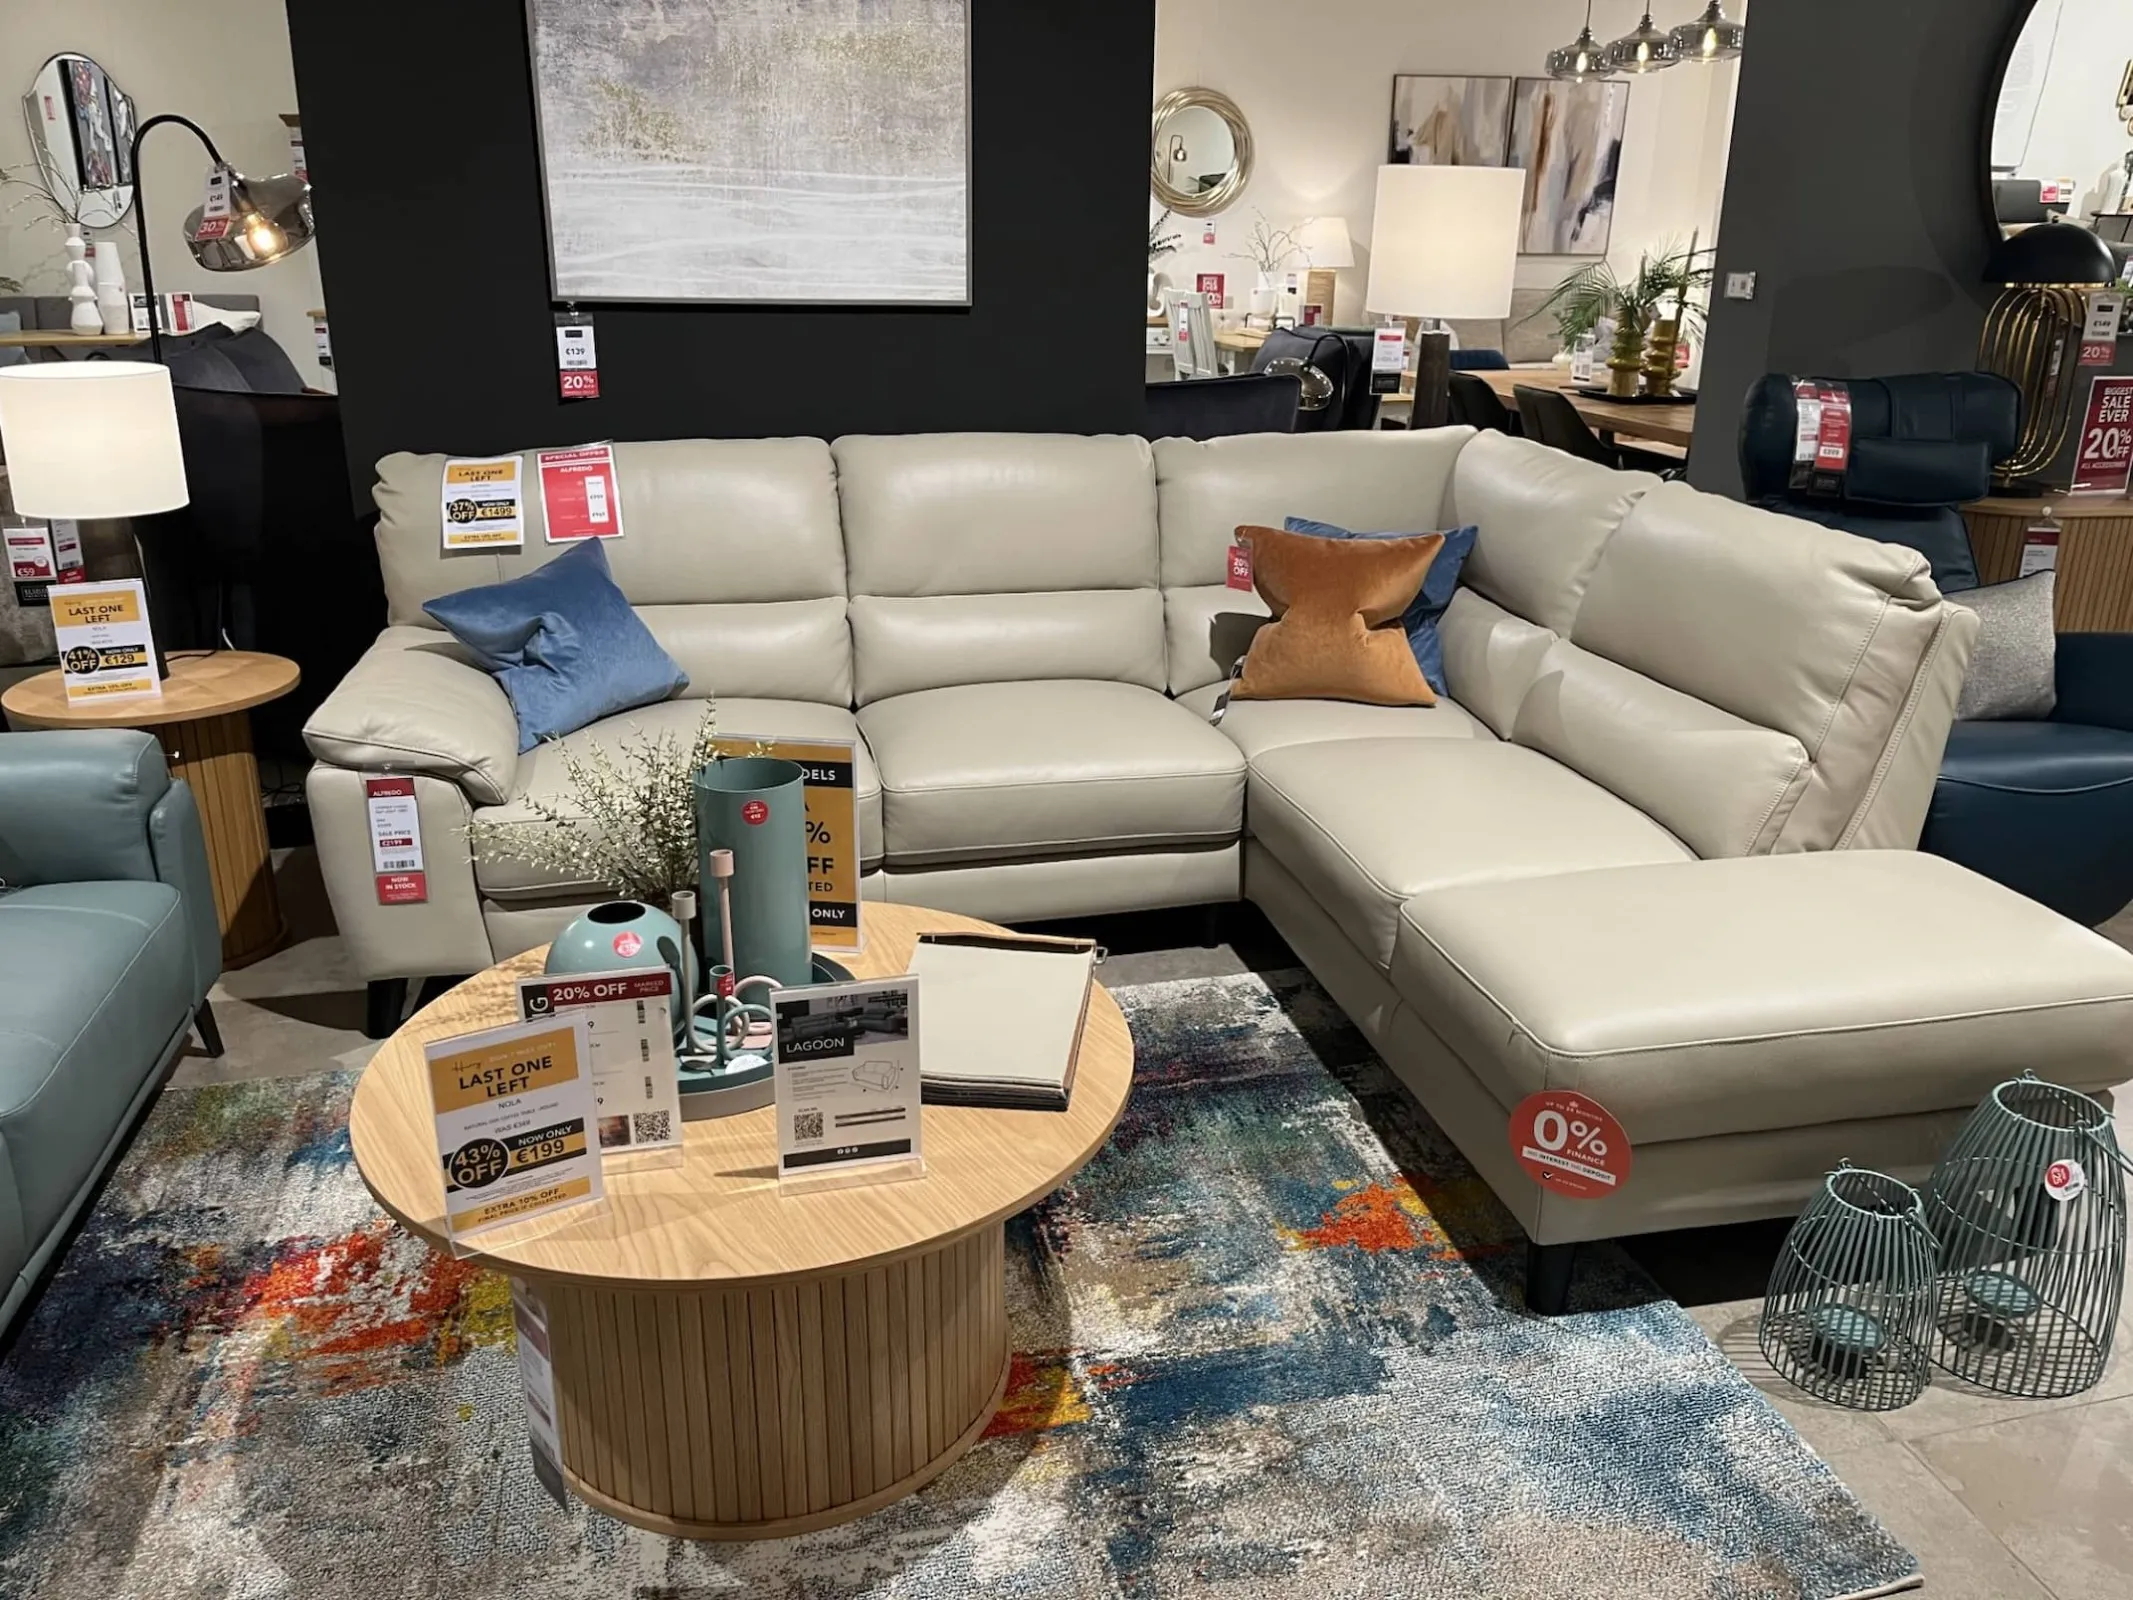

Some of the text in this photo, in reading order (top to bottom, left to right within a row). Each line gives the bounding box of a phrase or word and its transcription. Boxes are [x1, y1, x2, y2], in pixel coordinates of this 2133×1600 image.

[563, 375, 594, 389] 20%
[2104, 387, 2133, 395] BIGGEST
[2101, 396, 2131, 409] SALE
[2098, 409, 2130, 423] EVER
[2083, 427, 2132, 460] 20%
[452, 501, 475, 512] 37%
[481, 507, 513, 517] €1499
[452, 510, 475, 521] OFF
[68, 604, 124, 616] LAST ONE
[85, 614, 110, 623] LEFT
[68, 649, 96, 660] 41%
[104, 654, 135, 665] €129
[70, 659, 97, 671] OFF
[803, 768, 836, 781] DELS
[807, 856, 834, 875] FF
[812, 908, 846, 919] ONLY
[552, 982, 628, 1001] 20% OFF
[786, 1037, 845, 1054] LAGOON
[459, 1056, 552, 1090] LAST ONE
[486, 1076, 530, 1098] LEFT
[498, 1098, 522, 1110] NOLA
[518, 1125, 573, 1146] NOW ONLY
[1534, 1110, 1608, 1156] 0%
[456, 1142, 501, 1167] 43%
[516, 1140, 565, 1164] €199
[1566, 1148, 1606, 1167] FINANCE
[458, 1160, 502, 1184] OFF
[484, 1187, 560, 1215] EXTRA 10% OFF
